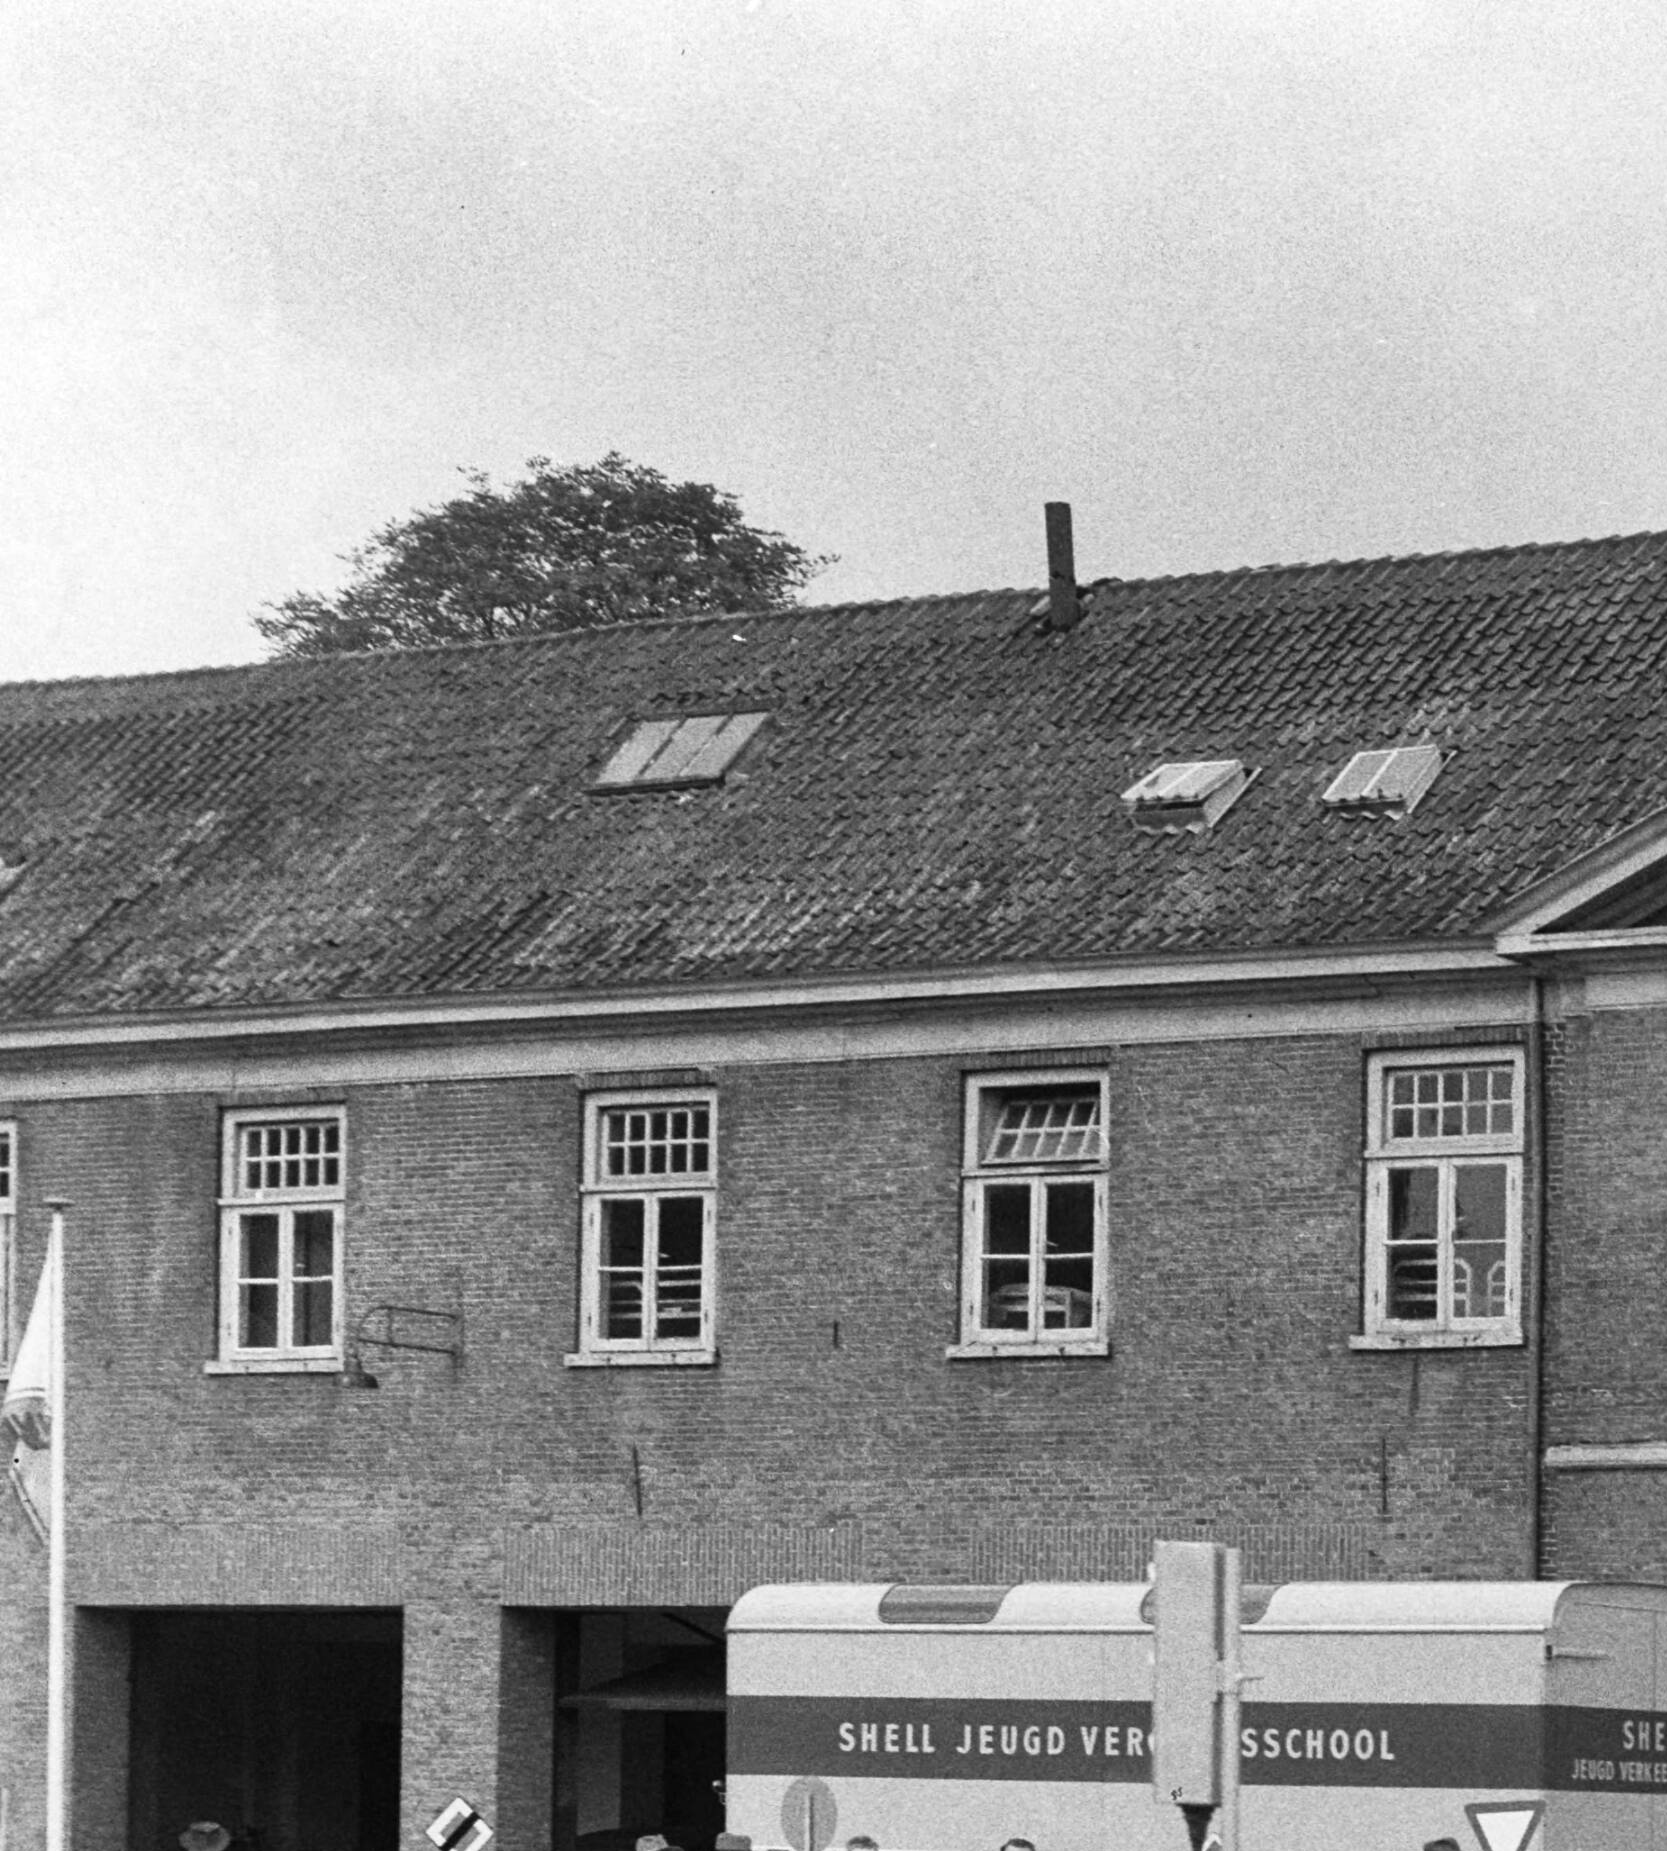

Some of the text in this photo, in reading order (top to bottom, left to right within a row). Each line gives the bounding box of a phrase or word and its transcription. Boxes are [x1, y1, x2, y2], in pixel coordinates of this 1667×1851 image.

[838, 1721, 1396, 1762] SHELL JEUGD VERSSCHOOL
[1571, 1758, 1616, 1781] JEUGD
